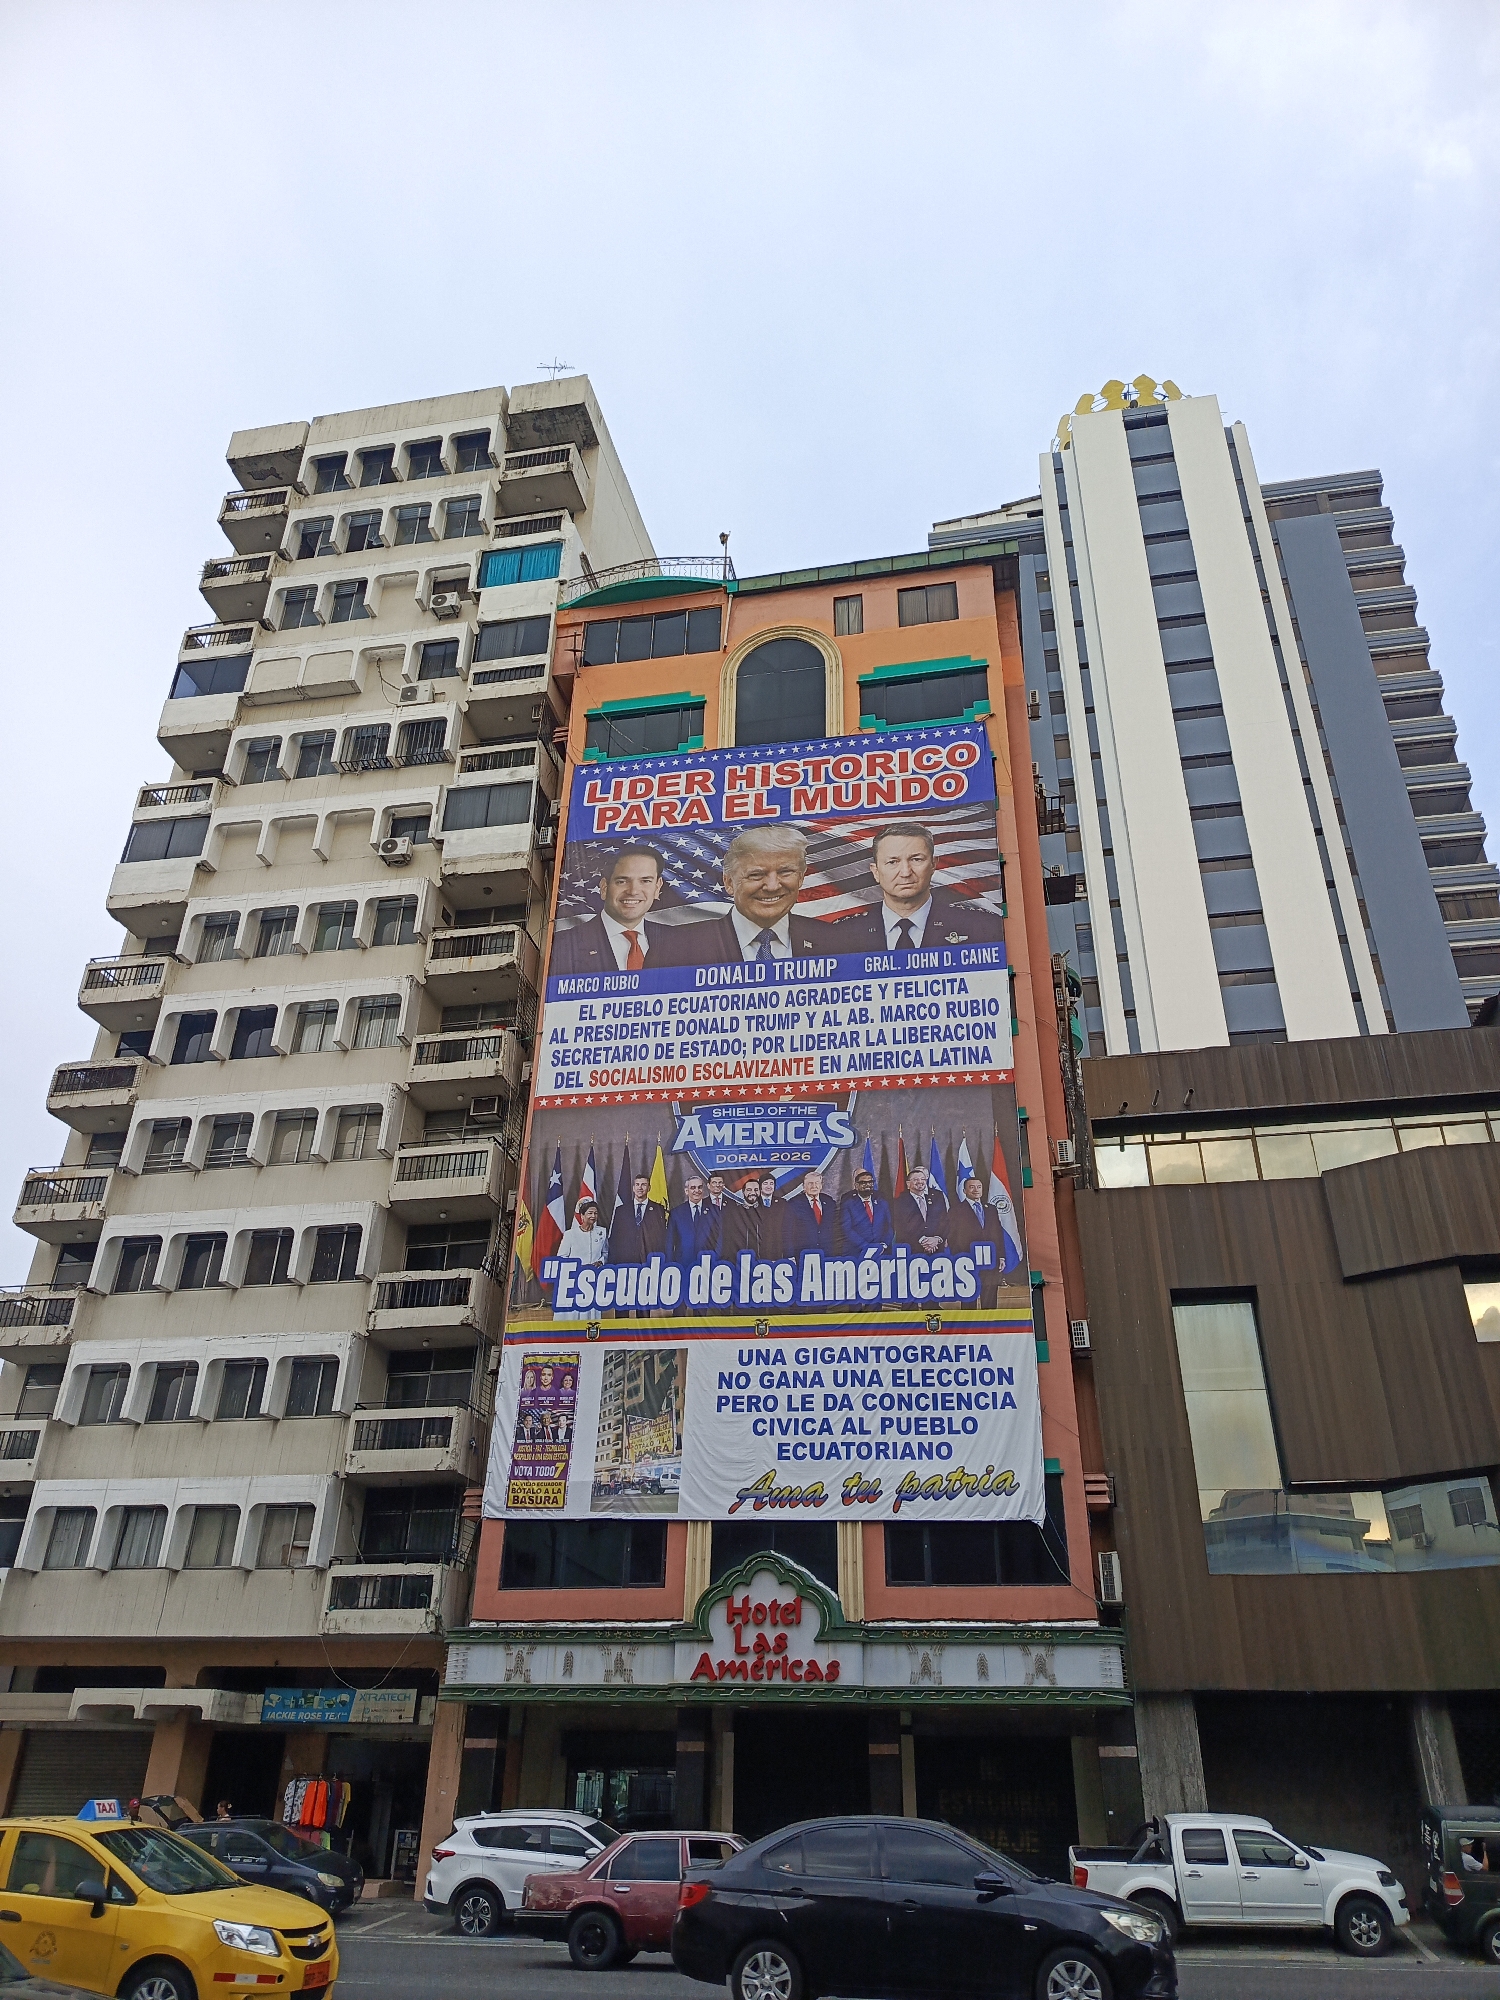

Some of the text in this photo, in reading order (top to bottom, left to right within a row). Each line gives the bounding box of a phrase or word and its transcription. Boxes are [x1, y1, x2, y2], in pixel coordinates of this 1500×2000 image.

[584, 741, 980, 806] LIDER HISTORICO
[593, 770, 968, 834] PARA EL MUNDO
[864, 946, 1000, 973] GRAL. JOHN D. CAINE
[557, 974, 640, 995] MARCO RUBIO
[695, 958, 838, 987] DONALD TRUMP
[578, 977, 969, 1021] EL PUEBLO ECUATORIANO AGRADECE Y FELICITA
[549, 997, 1000, 1045] AL PRESIDENTE DONALD TRUMP Y AL AB. MARCO RUBIO
[550, 1021, 997, 1068] SECRETARIO DE ESTADO; POR LIDERAR LA LIBERACION
[553, 1045, 993, 1090] DEL SOCIALISMO ESCLAVIZANTE EN AMERICA LATINA
[712, 1105, 818, 1118] SHIELD OF THE
[671, 1111, 857, 1152] AMERICAS
[716, 1151, 812, 1164] DORAL 2026
[543, 1245, 992, 1309] "Escudo de las Américas"
[737, 1344, 993, 1367] UNA GIGANTOGRAFIA
[717, 1366, 1015, 1390] NO GANA UNA ELECCION
[716, 1391, 1018, 1413] PERO LE DA CONCIENCIA
[751, 1415, 979, 1437] CIVICA AL PUEBLO
[776, 1441, 954, 1462] ECUATORIANO
[514, 1465, 533, 1477] VOTA
[534, 1465, 555, 1477] TODO
[553, 1462, 566, 1479] 7
[512, 1495, 559, 1505] BASURA
[552, 1487, 562, 1495] LA
[728, 1465, 1020, 1515] Ama tu patria
[726, 1594, 803, 1626] Hotel
[733, 1623, 788, 1655] Las
[690, 1652, 841, 1682] Américas
[359, 1693, 412, 1702] XTRATECH
[266, 1711, 297, 1720] JACKIE
[297, 1711, 323, 1720] ROSE
[96, 1802, 117, 1814] TAXI
